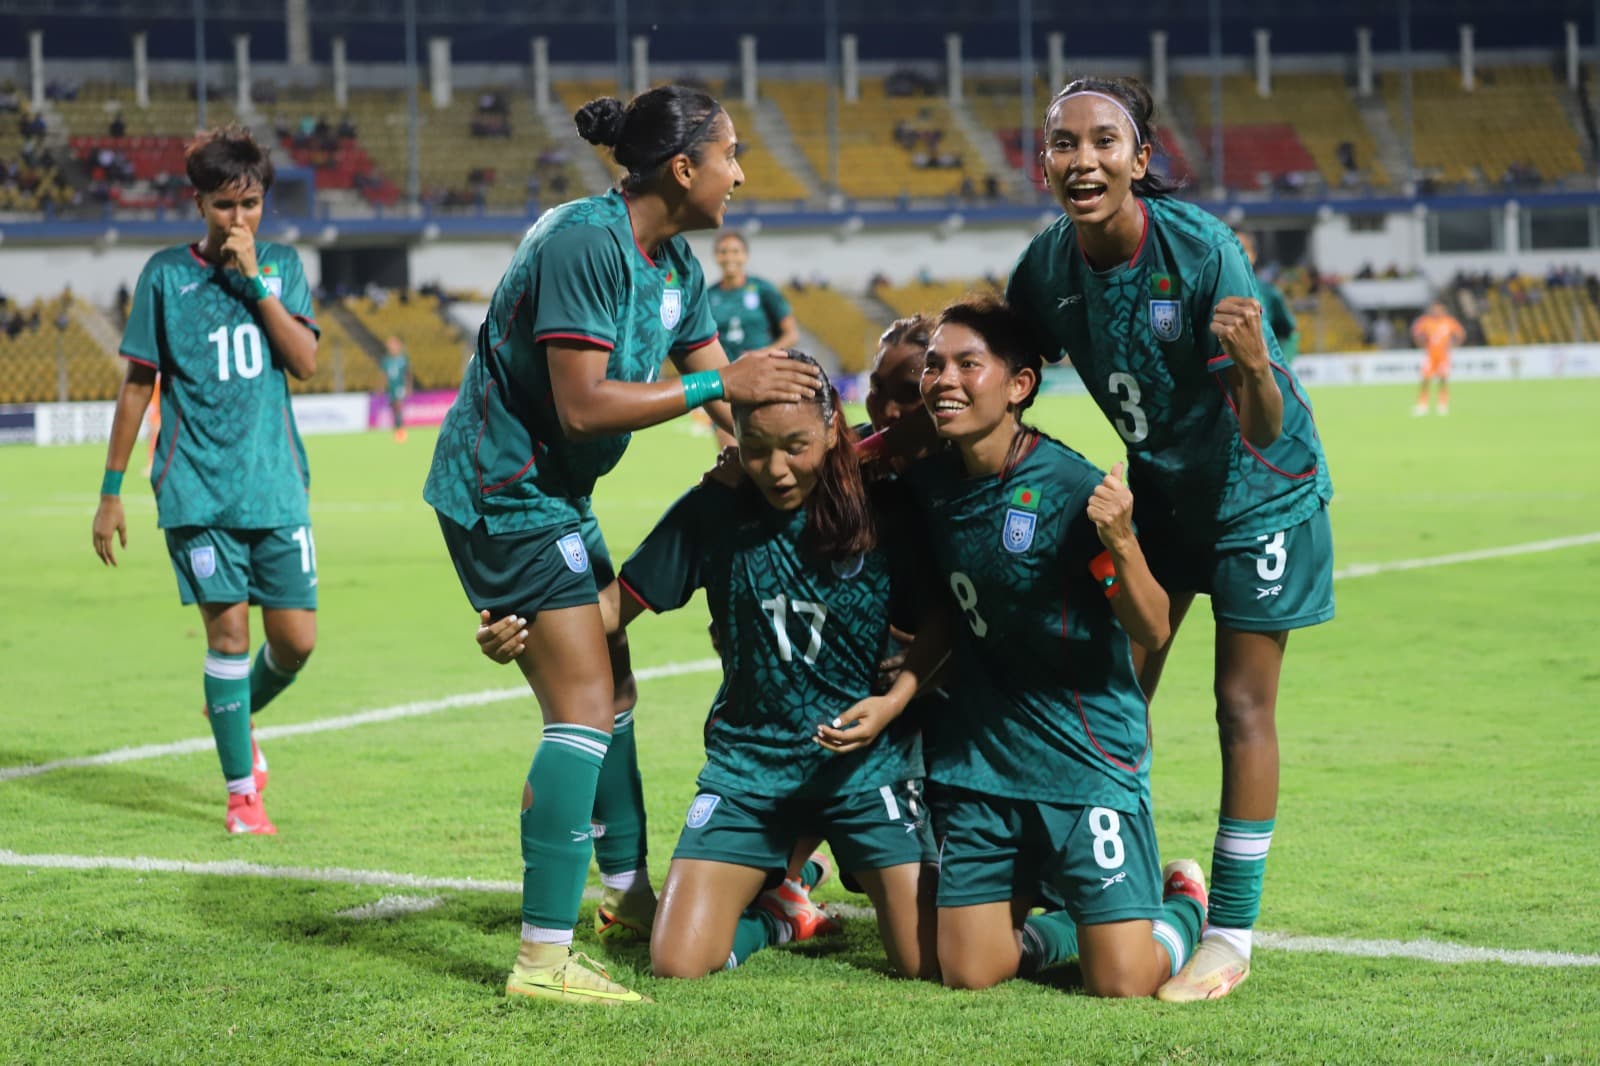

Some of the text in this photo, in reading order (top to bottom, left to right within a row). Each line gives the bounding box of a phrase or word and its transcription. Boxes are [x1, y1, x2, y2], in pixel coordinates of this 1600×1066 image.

[208, 323, 264, 381] 10
[1108, 372, 1149, 443] 3
[1256, 531, 1287, 581] 3
[762, 593, 827, 664] 17
[1089, 806, 1125, 870] 8
